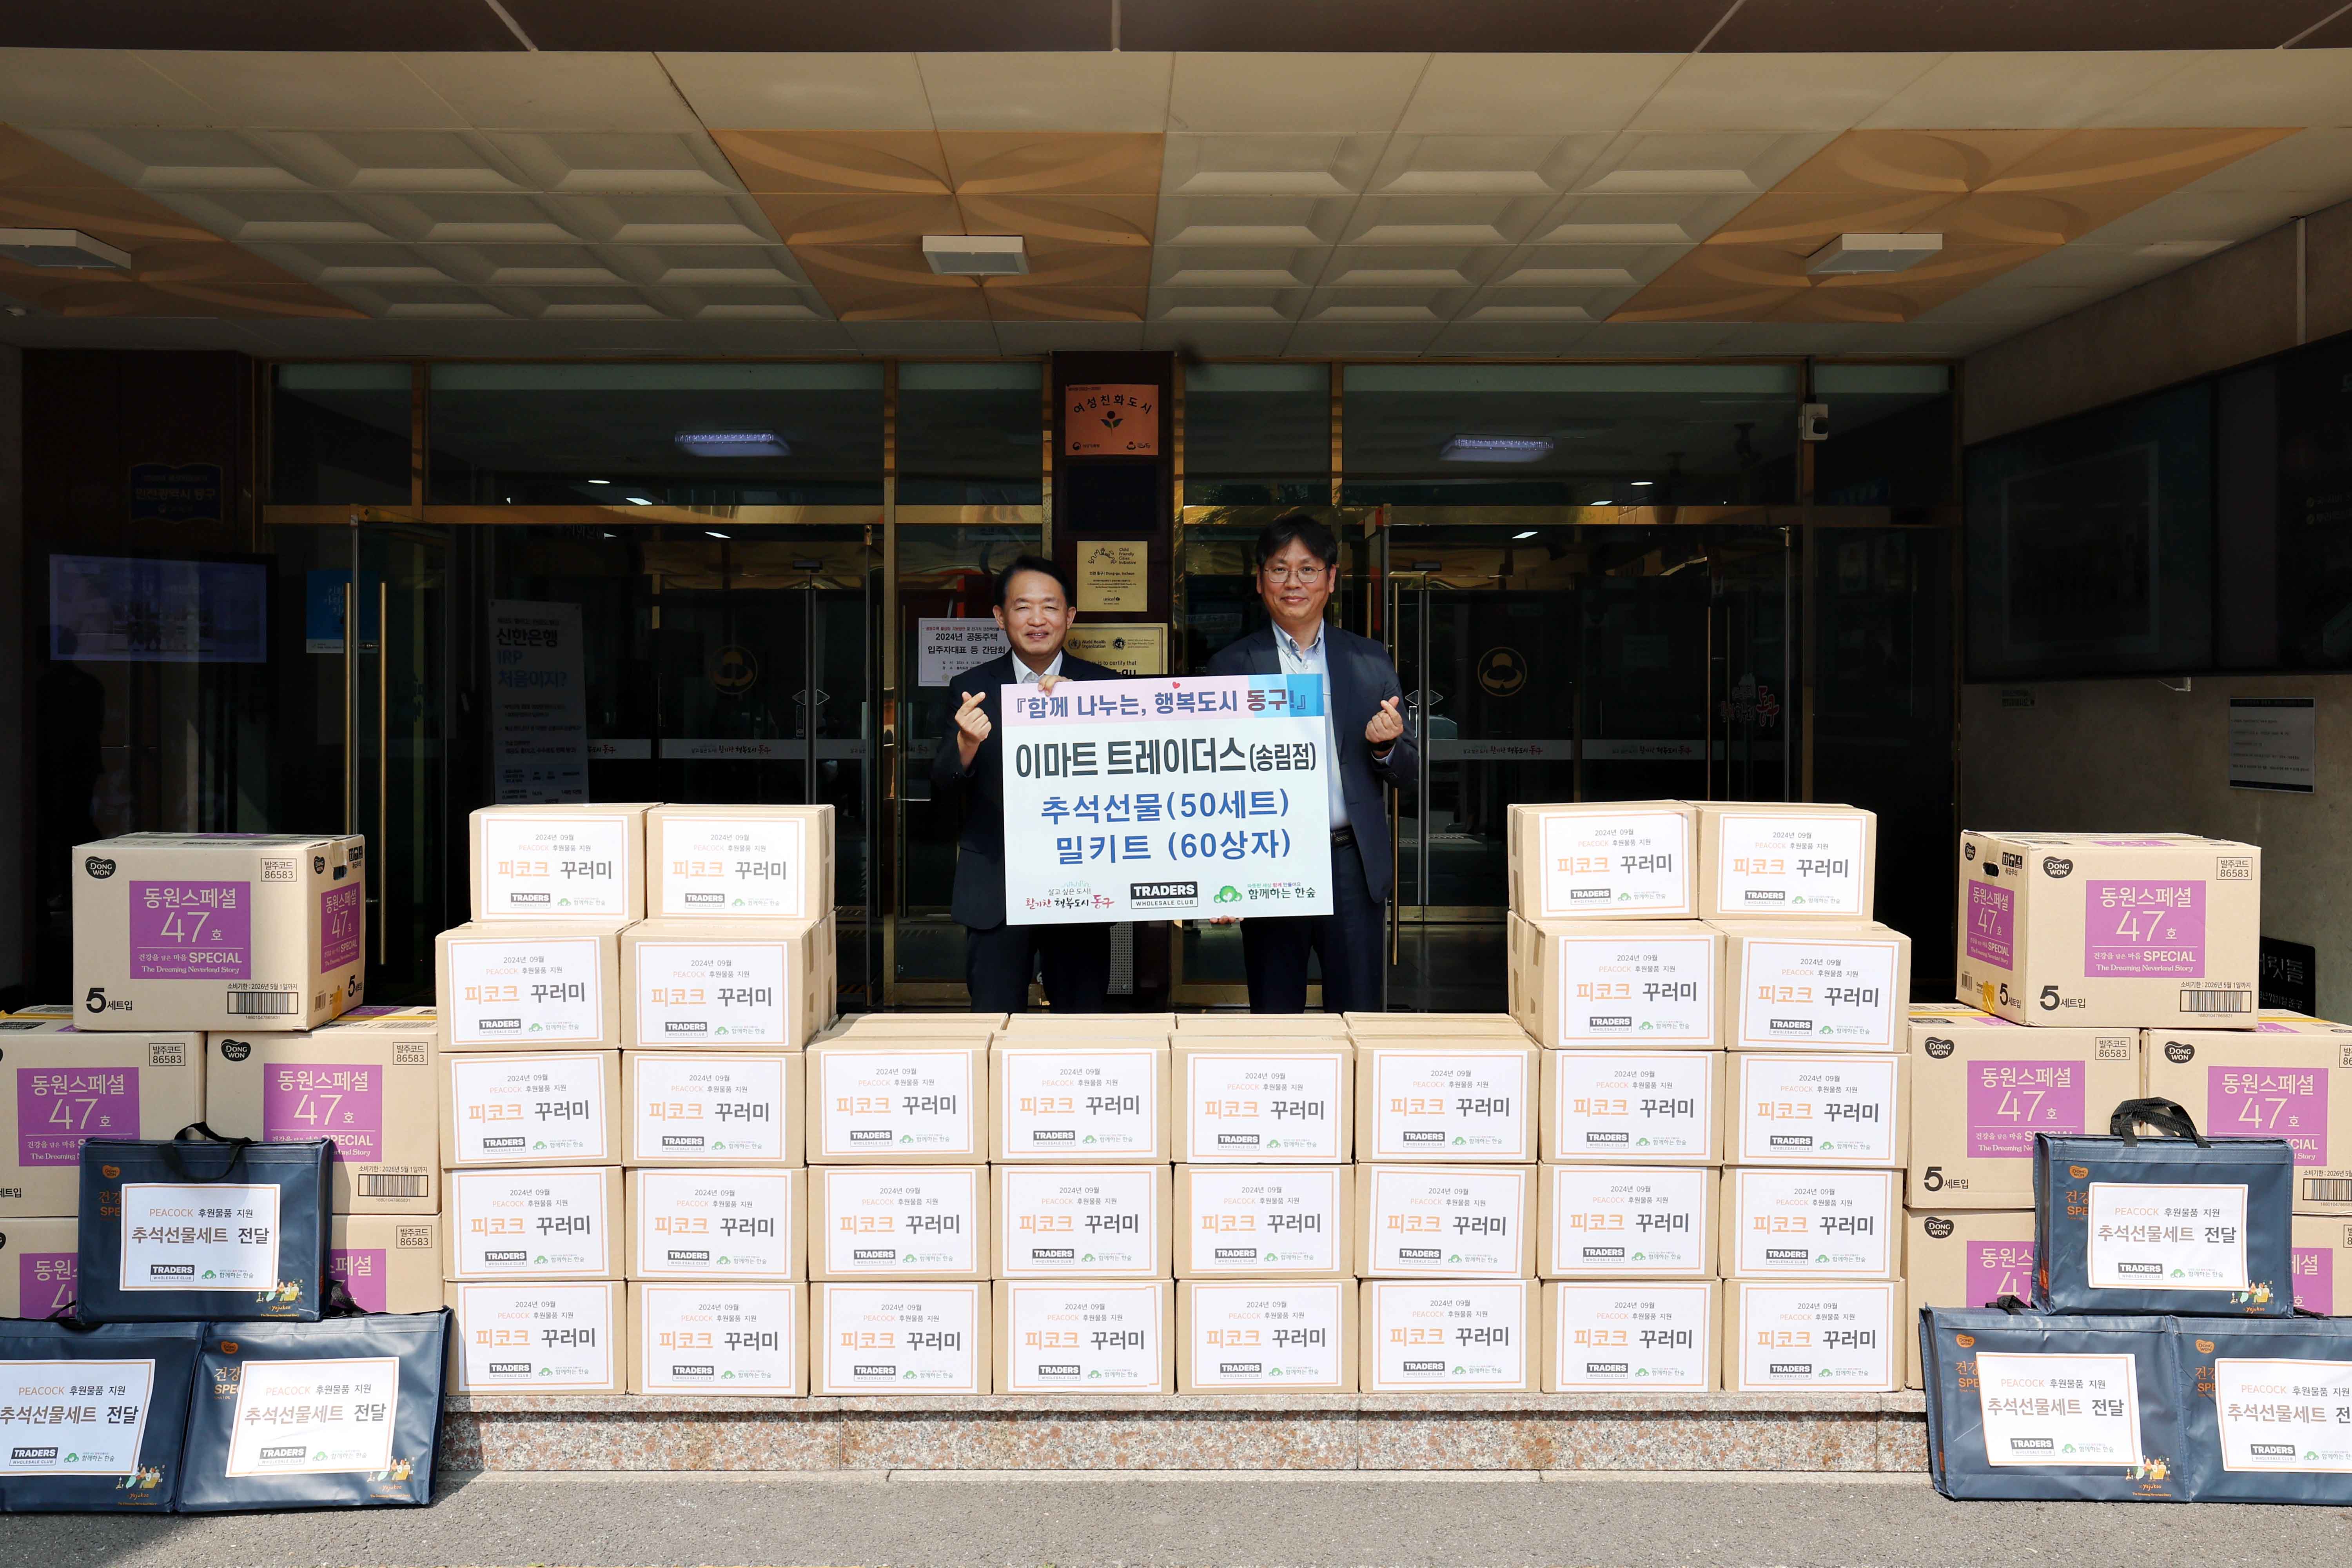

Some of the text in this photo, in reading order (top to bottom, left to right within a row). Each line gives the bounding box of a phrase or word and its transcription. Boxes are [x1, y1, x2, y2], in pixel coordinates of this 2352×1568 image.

[1074, 394, 1152, 414] 여성친화도시
[497, 628, 558, 647] 신한은행
[967, 633, 998, 641] 공동주택
[496, 651, 523, 664] IRP
[928, 646, 1005, 654] 입주자대표 등 간담회
[497, 669, 567, 689] 처음이지?
[1077, 694, 1146, 716] 나누는,
[1154, 690, 1238, 715] 행복도시
[1016, 741, 1097, 779] 이마트
[1041, 788, 1289, 825] 추석선물(50세트)
[1056, 829, 1291, 865] 밀키트 (60상자)
[90, 862, 113, 871] DONG
[264, 861, 293, 870] 발주코드
[498, 860, 612, 879] 피코크 꾸러미
[1557, 854, 1672, 876] 피코크 꾸러미
[2221, 859, 2249, 868] 발주코드
[264, 871, 293, 879] 86583
[2220, 869, 2249, 877] 86583
[143, 887, 236, 909] 동원스페셜
[1134, 884, 1195, 897] TRADERS
[1248, 887, 1316, 900] 함께하는 한숲
[1973, 886, 2008, 911] 동원스페셜
[2100, 887, 2191, 908] 동원스페셜
[1025, 894, 1115, 909] 활기찬 행복도시 동구
[139, 953, 158, 962] 건강을
[189, 953, 242, 963] SPECIAL
[1988, 942, 2009, 956] SPECIAL
[2143, 951, 2196, 962] SPECIAL
[1635, 965, 1659, 973] 후원물품
[1663, 965, 1675, 973] 지원
[2175, 964, 2193, 973] Story
[652, 987, 772, 1007] 피코크 꾸러미
[1576, 982, 1697, 1003] 피코크 꾸러미
[1591, 1017, 1630, 1026] TRADERS
[31, 1074, 124, 1095] 동원스페셜
[277, 1071, 368, 1091] 동원스페셜
[1981, 1067, 2071, 1088] 동원스페셜
[2222, 1073, 2314, 1095] 동원스페셜
[837, 1095, 956, 1116] 피코크 꾸러미
[150, 1209, 253, 1218] PEACOCK 후원물품 지원
[2115, 1207, 2220, 1218] PEACOCK 후원물품 지원
[132, 1227, 269, 1244] 추석선물세트 전달
[2098, 1225, 2236, 1243] 추석선물세트 전달
[153, 1266, 193, 1274] TRADERS
[1207, 1328, 1326, 1348] 피코크 꾸러미
[245, 1403, 386, 1426] 추석선물세트 전달
[1988, 1398, 2124, 1416] 추석선물세트 전달
